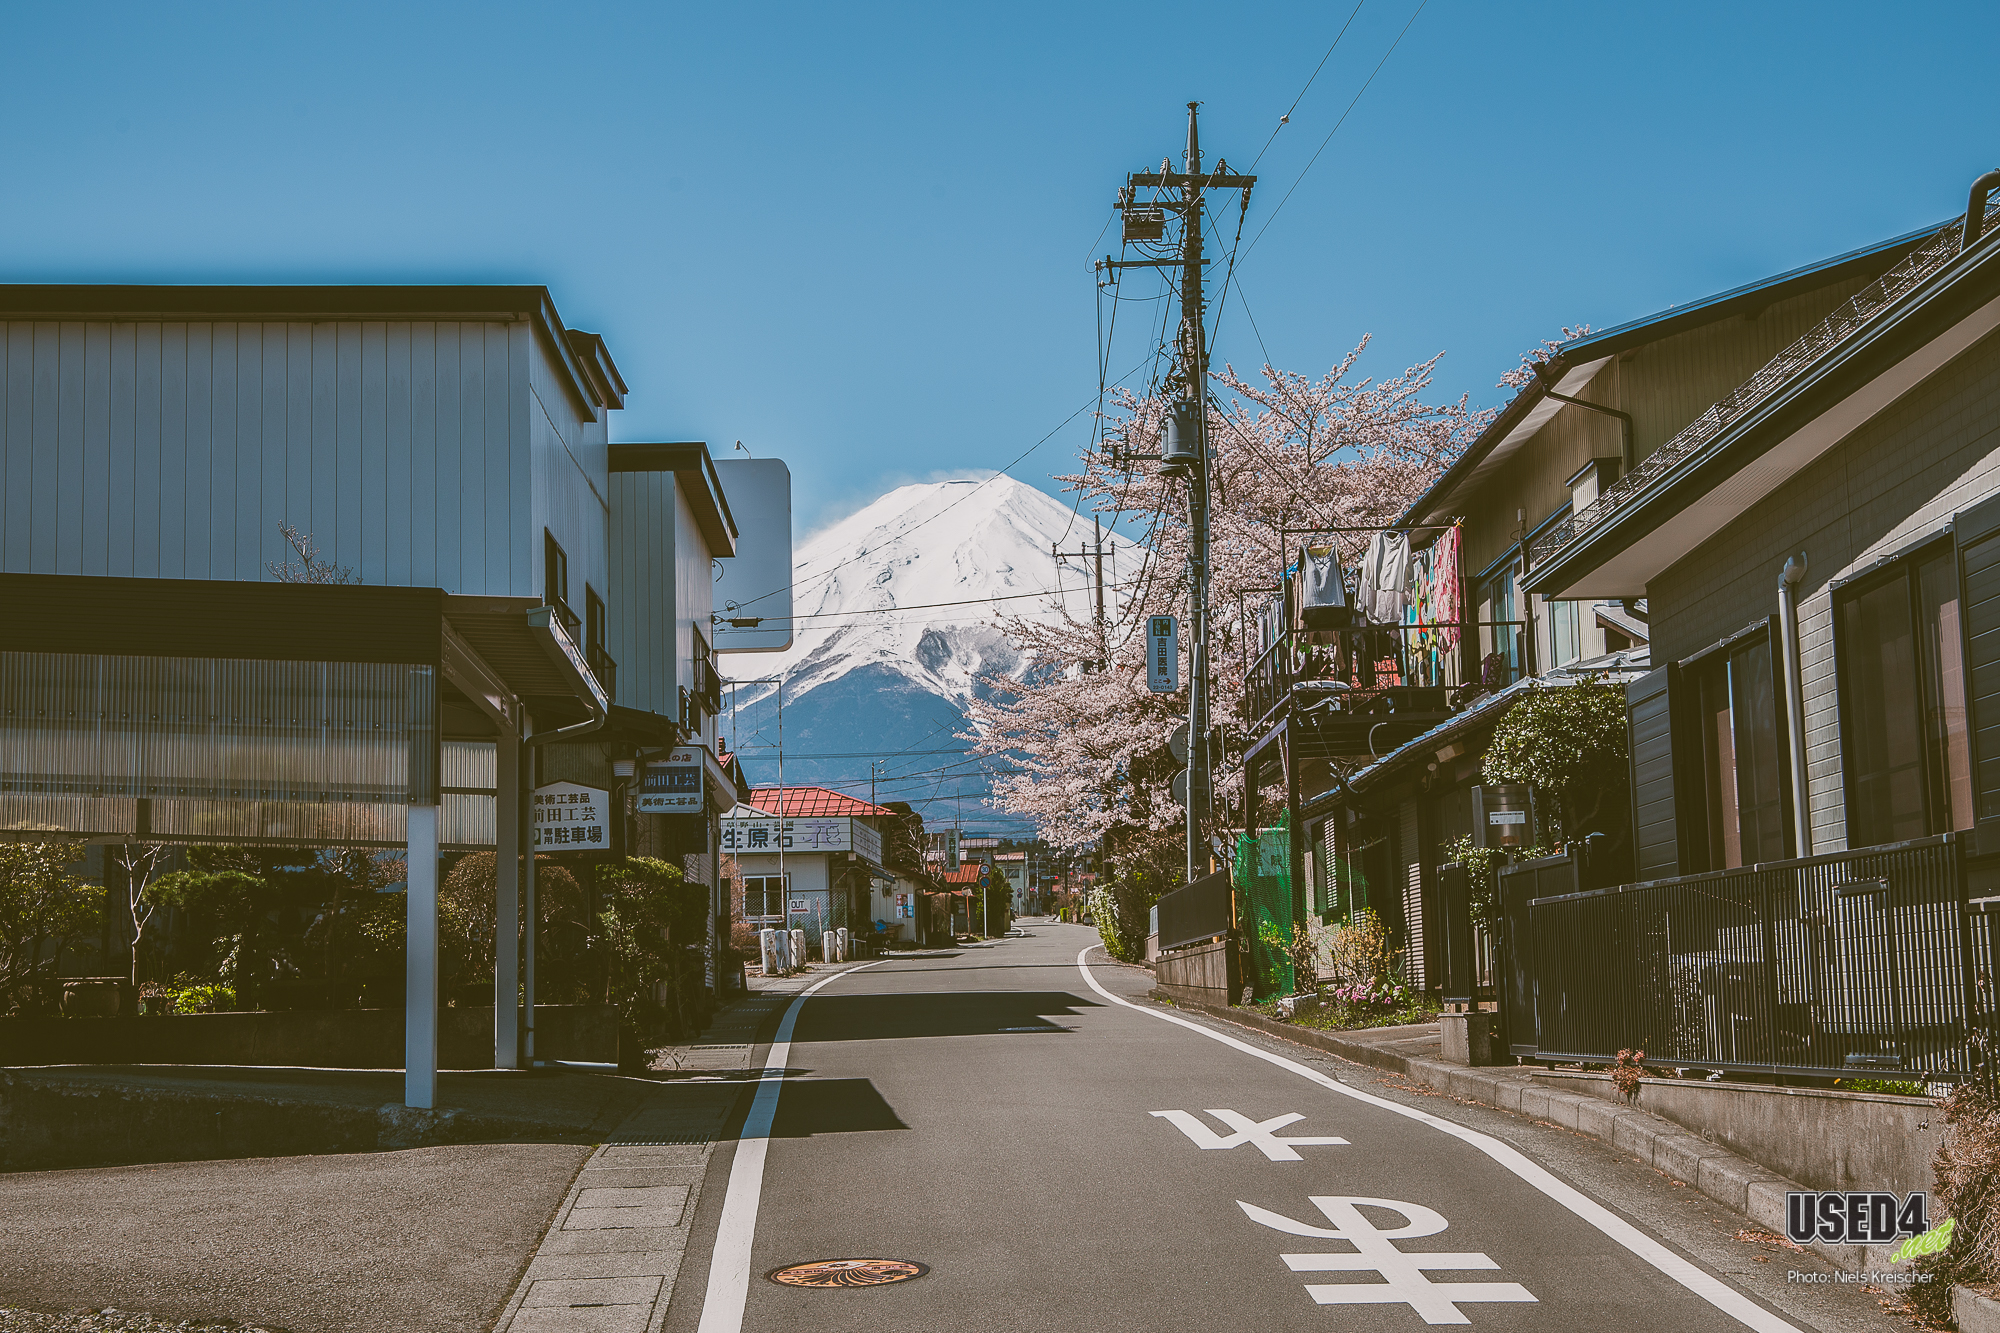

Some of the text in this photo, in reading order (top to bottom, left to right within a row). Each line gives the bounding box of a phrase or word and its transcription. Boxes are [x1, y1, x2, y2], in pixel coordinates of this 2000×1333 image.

[1157, 637, 1168, 676] 吉田医院
[645, 773, 696, 787] 前田工芸
[534, 792, 591, 806] 美術工芸品
[641, 796, 698, 807] 美術工芸品
[791, 900, 805, 909] OUT
